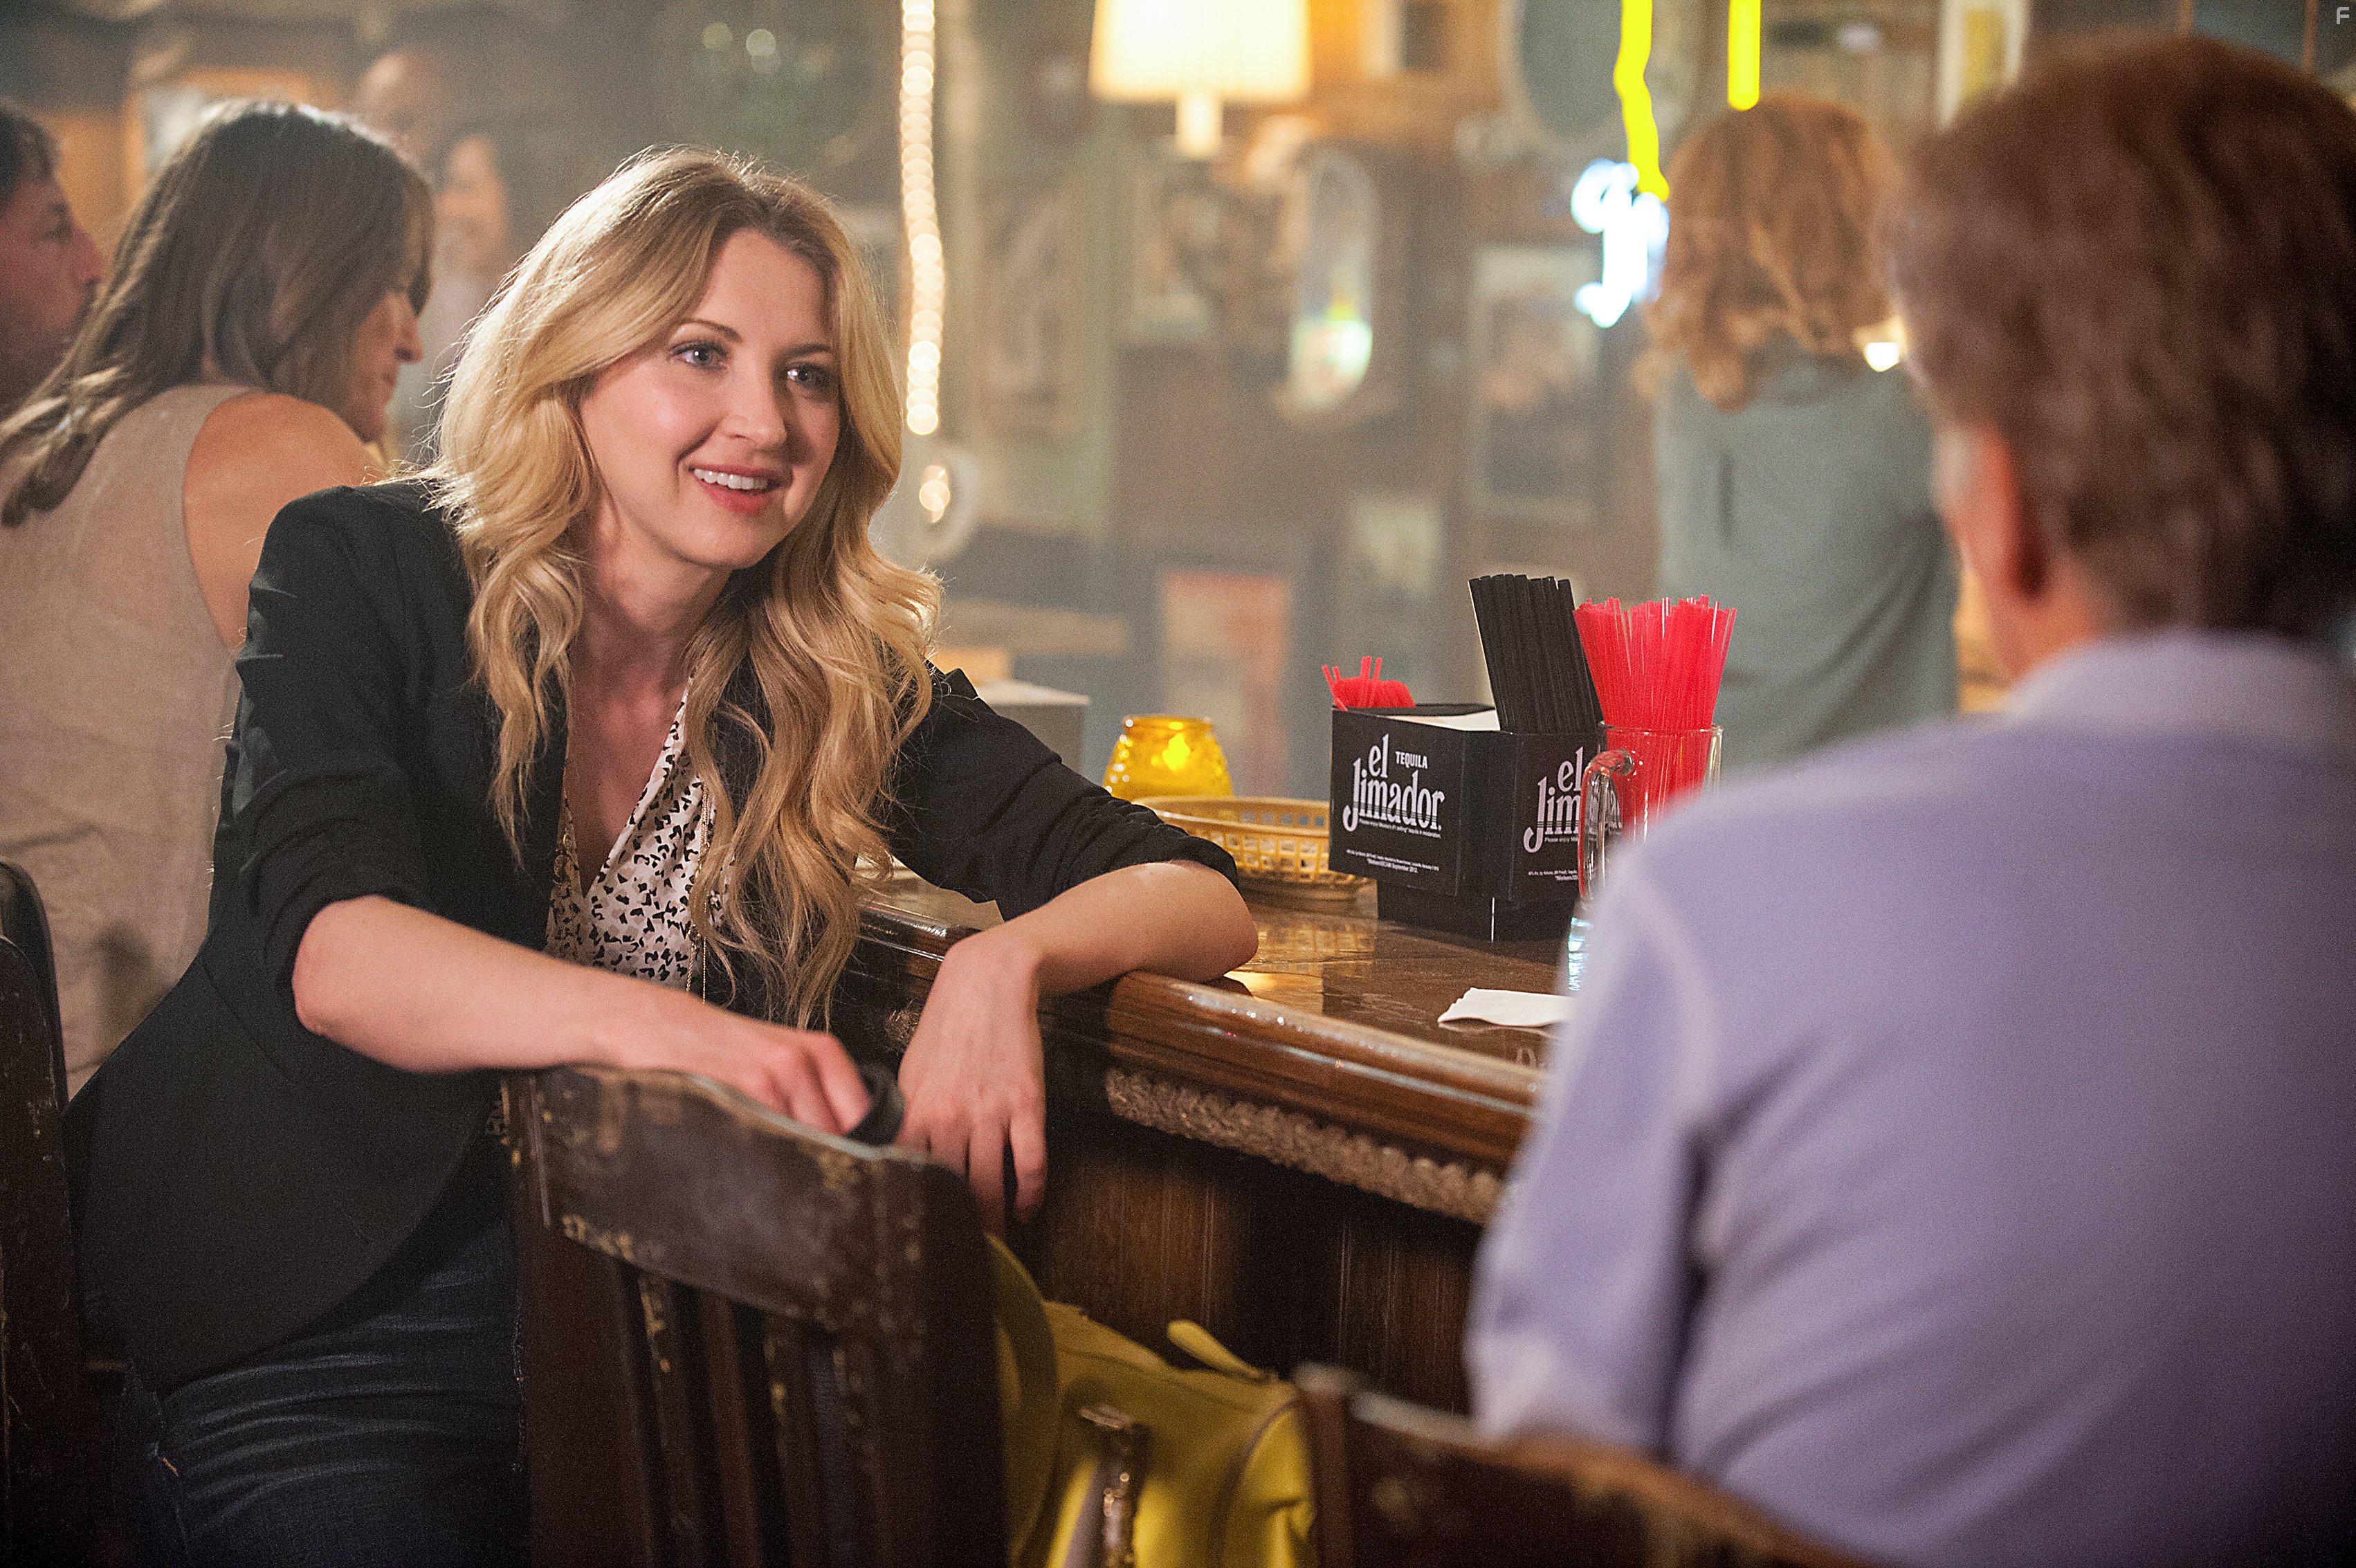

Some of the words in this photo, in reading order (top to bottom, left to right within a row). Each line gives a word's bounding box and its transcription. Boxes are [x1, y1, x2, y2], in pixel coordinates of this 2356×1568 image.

[1368, 733, 1389, 778] el
[1395, 750, 1428, 769] TEQUILA
[1557, 746, 1583, 792] el
